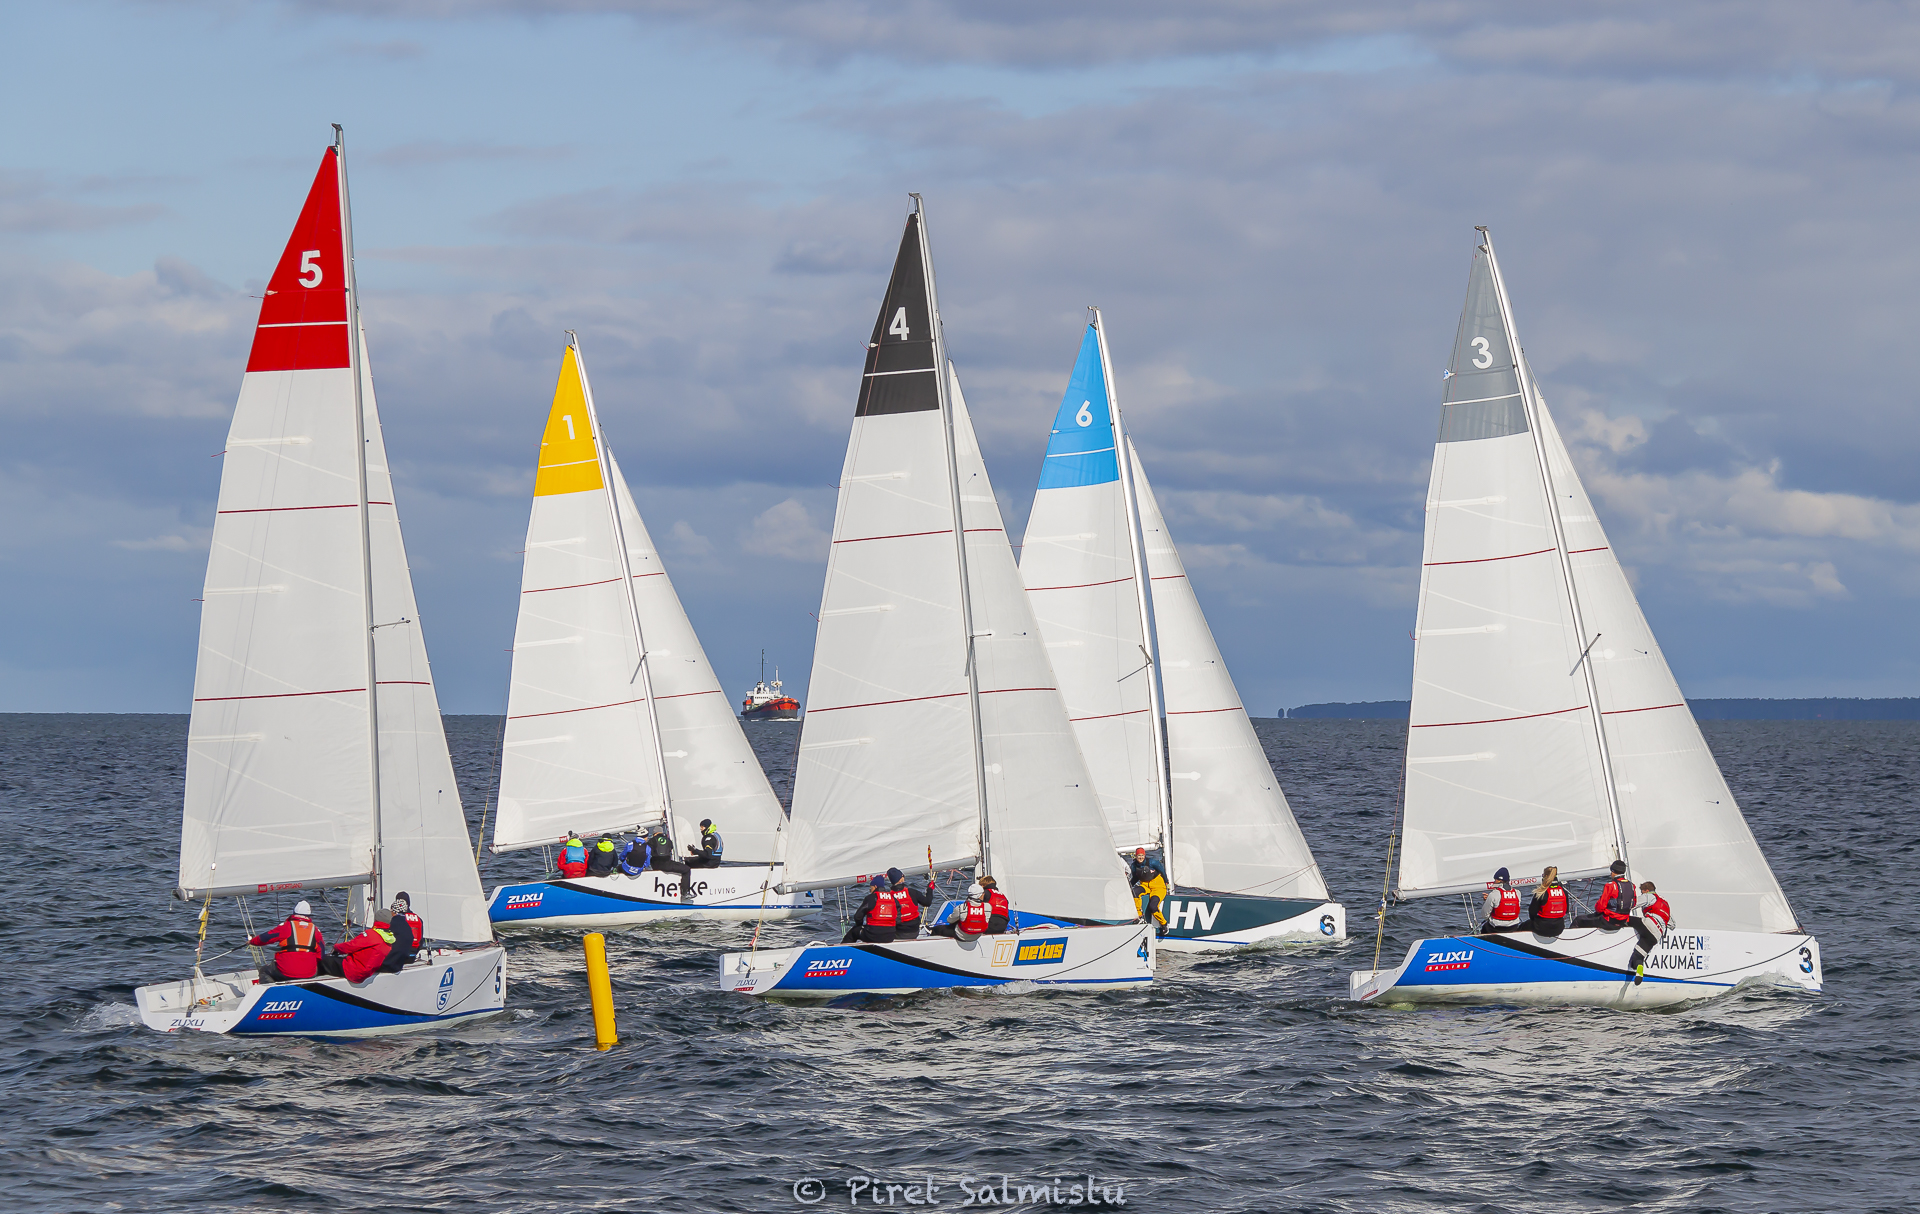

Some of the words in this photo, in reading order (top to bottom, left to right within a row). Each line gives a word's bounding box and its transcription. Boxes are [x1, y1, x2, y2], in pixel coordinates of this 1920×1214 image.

[298, 249, 323, 289] 5
[889, 306, 910, 341] 4
[1470, 336, 1493, 369] 3
[1075, 399, 1093, 427] 6
[562, 414, 576, 440] 1
[507, 892, 544, 904] ZUXU
[709, 886, 736, 896] LIVING
[970, 907, 983, 915] HH
[1319, 915, 1335, 936] 6
[1018, 940, 1064, 961] vetus
[1136, 936, 1150, 962] 4
[1661, 935, 1704, 950] HAVEN
[807, 958, 853, 970] ZUXU
[1427, 950, 1474, 964] ZUXU
[1798, 946, 1814, 974] 3
[494, 965, 502, 995] 5
[262, 1000, 304, 1012] ZUXU
[170, 1019, 205, 1027] ZUXU
